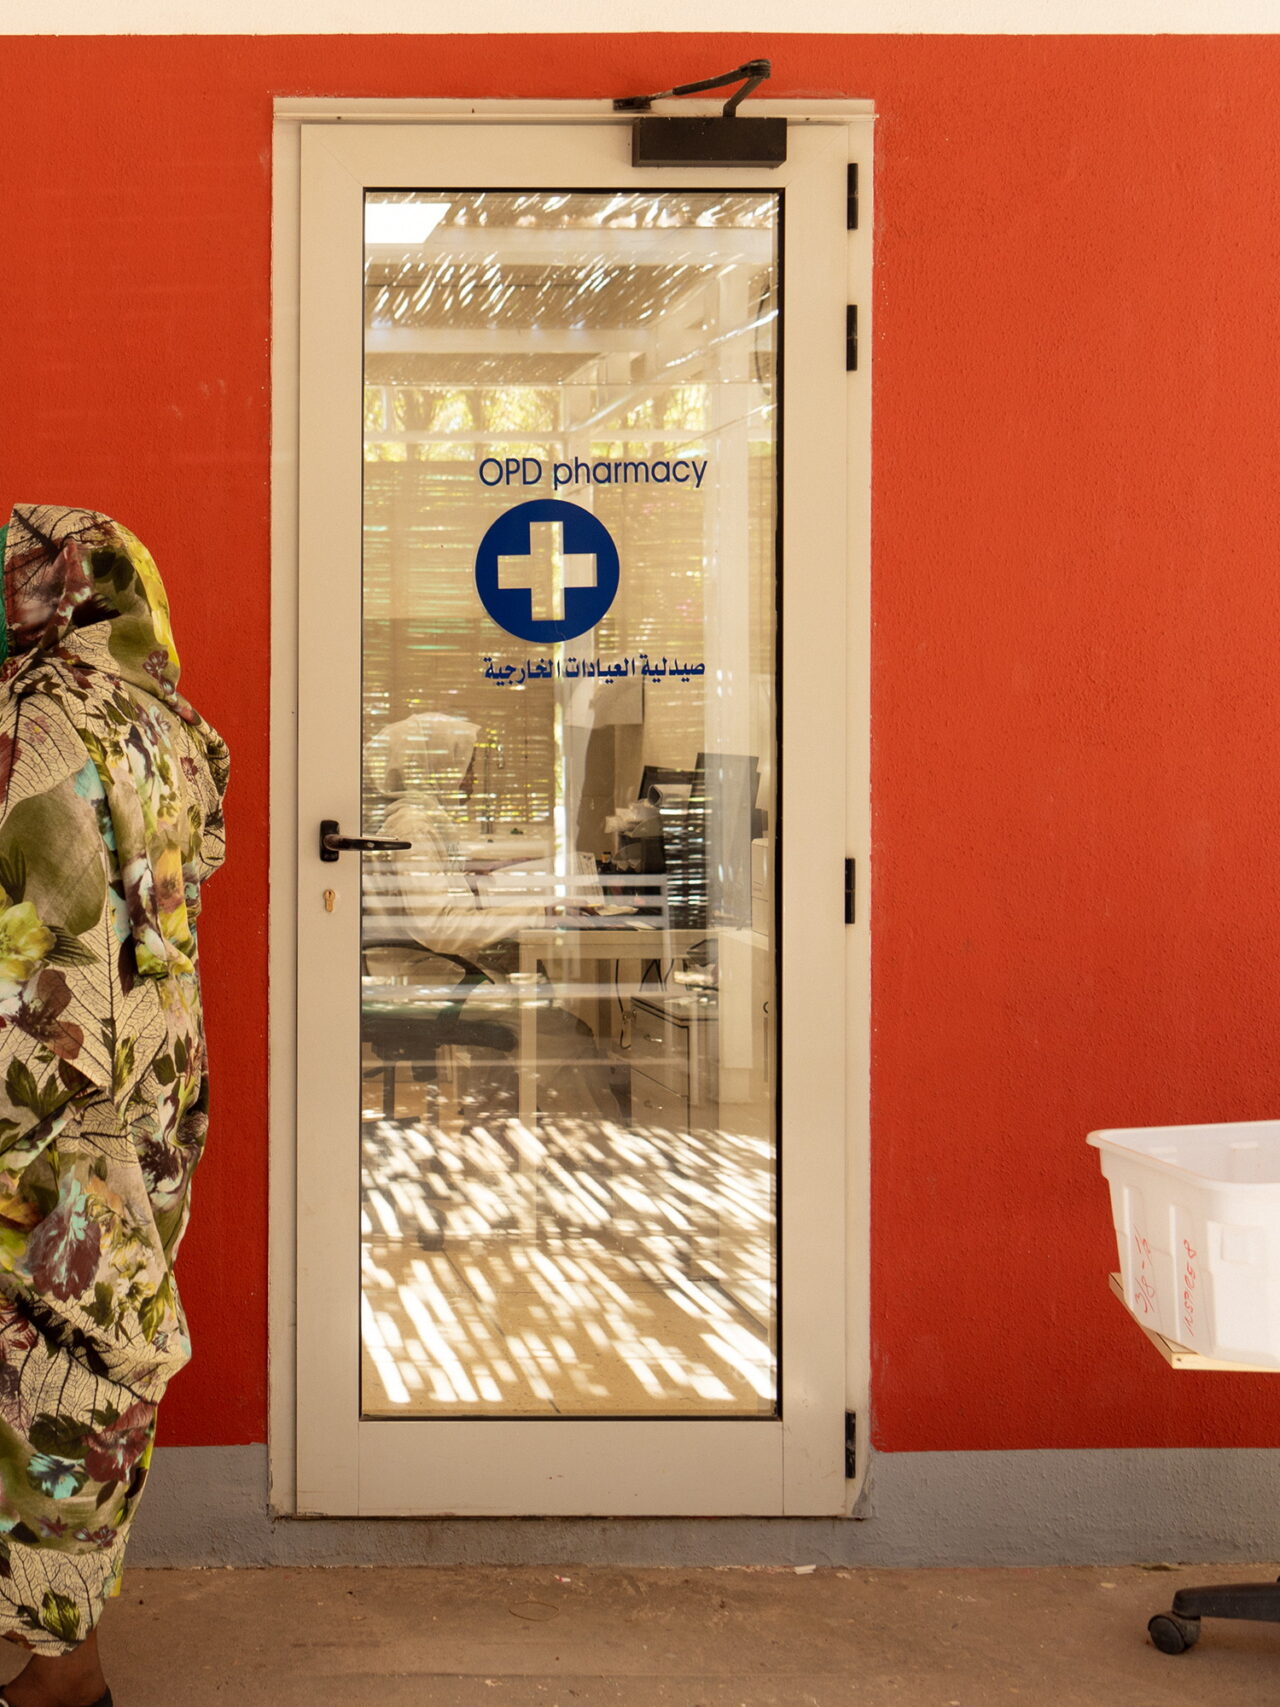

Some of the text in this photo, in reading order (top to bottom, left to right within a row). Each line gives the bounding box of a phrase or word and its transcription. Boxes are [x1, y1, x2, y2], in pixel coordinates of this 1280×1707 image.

[479, 456, 708, 490] OPD pharmacy
[483, 654, 705, 686] صيدلية العيادات الخارجية
